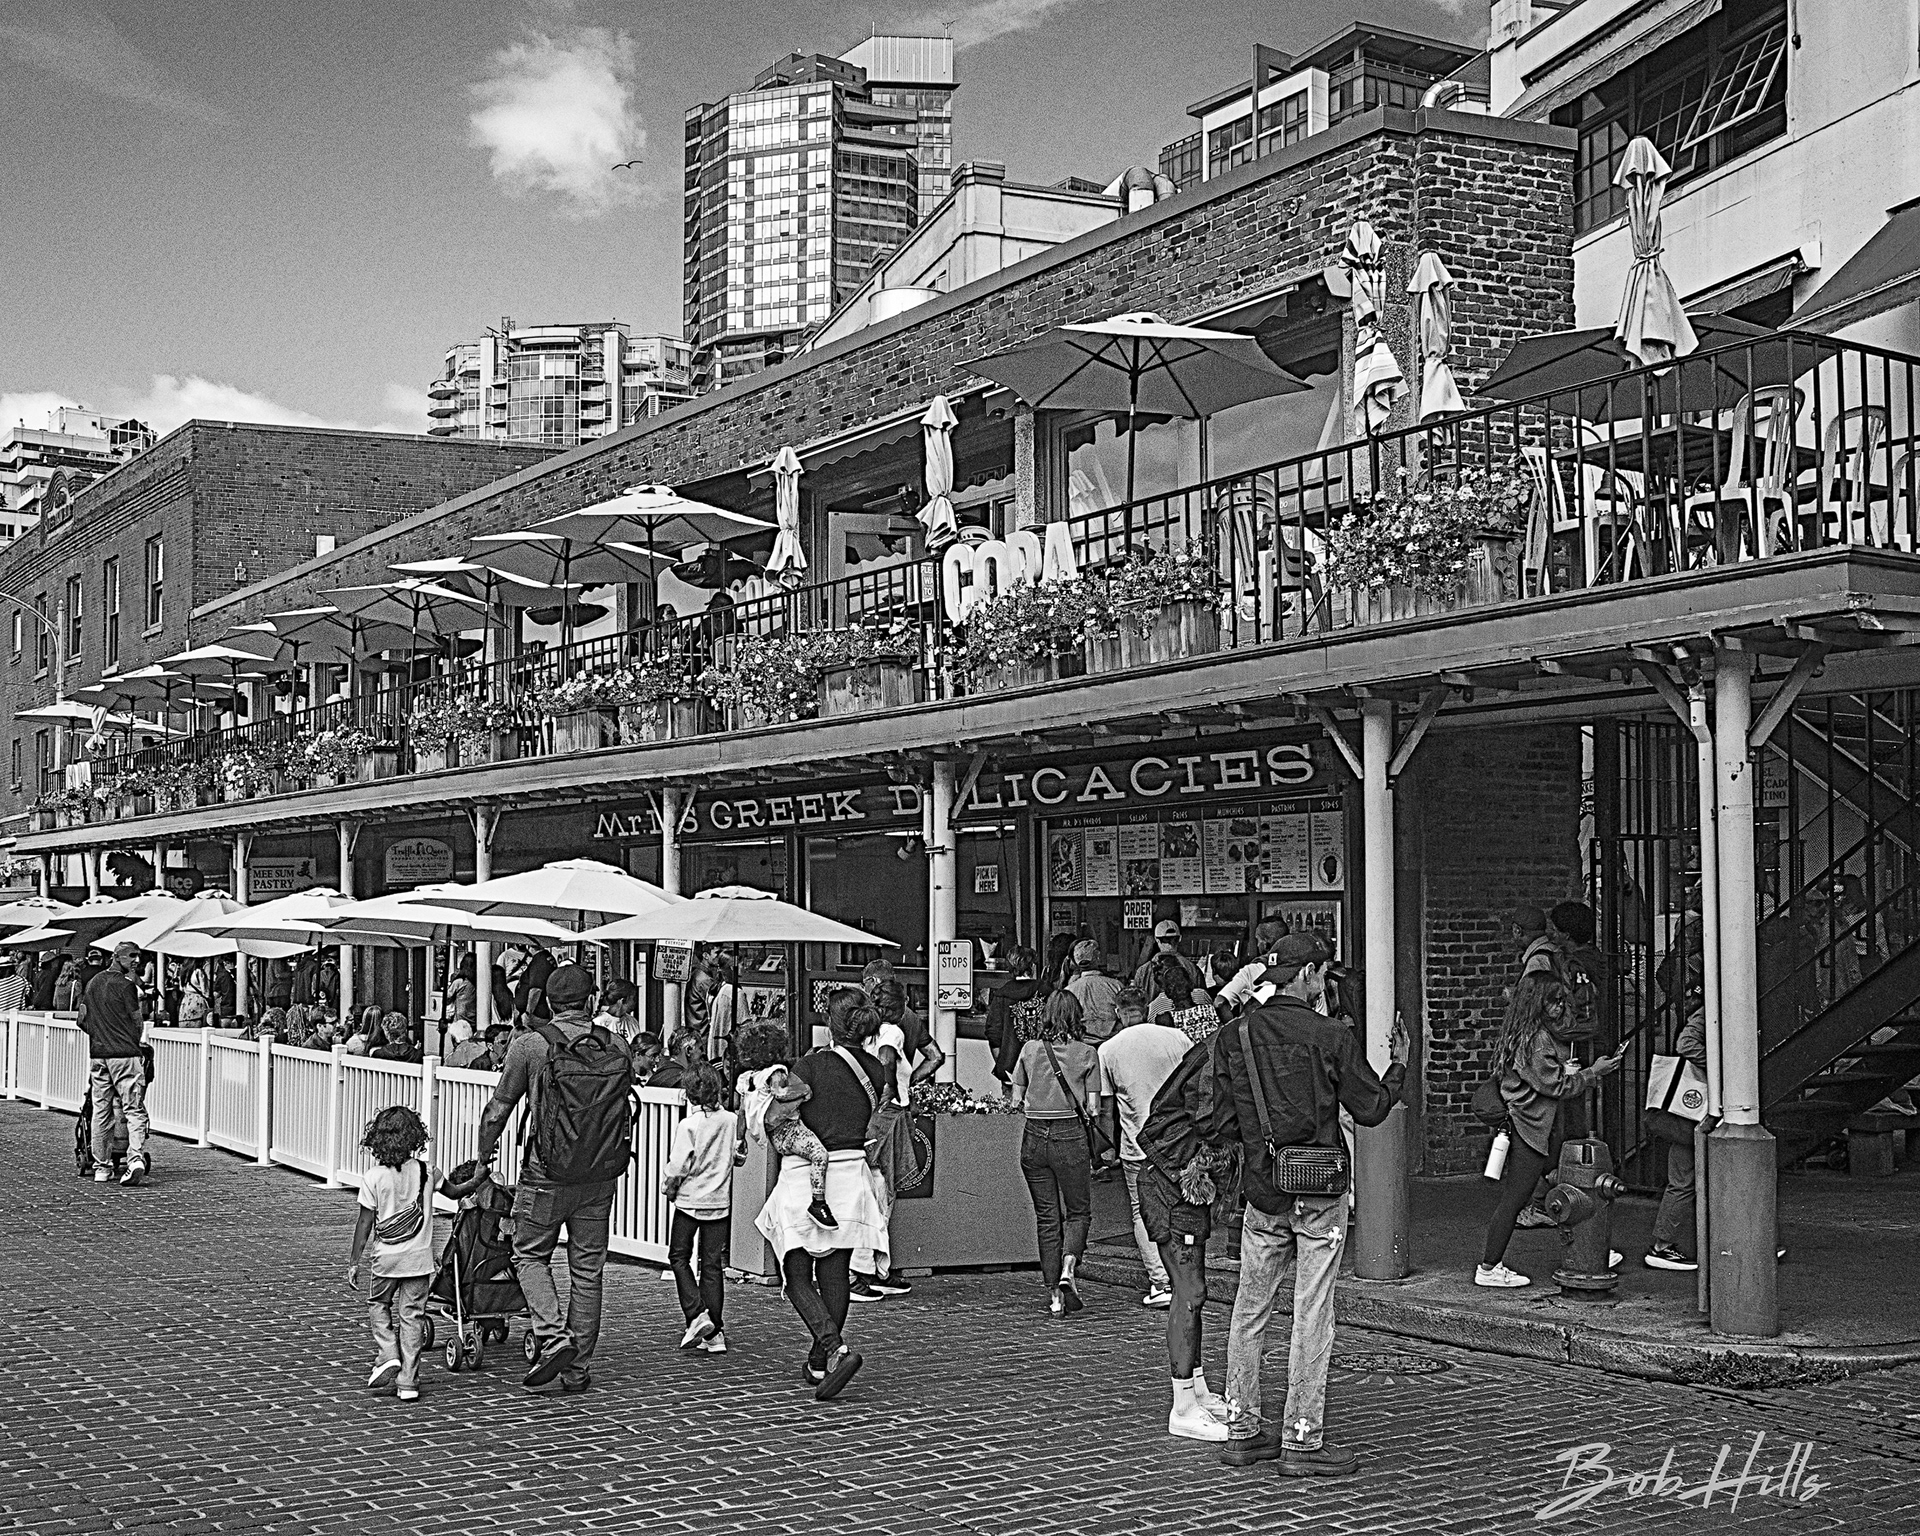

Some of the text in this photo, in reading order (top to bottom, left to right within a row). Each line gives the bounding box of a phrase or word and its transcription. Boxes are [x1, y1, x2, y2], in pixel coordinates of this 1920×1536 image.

[967, 468, 1003, 485] OPEN
[943, 521, 1077, 626] COPA
[709, 789, 866, 830] GREEK
[887, 743, 1315, 816] DLICACIES
[1271, 803, 1296, 813] PASTRIES
[1321, 800, 1339, 810] SIDES
[1172, 810, 1188, 820] FRIES
[1216, 807, 1245, 817] MUNCHIES
[1129, 813, 1148, 823] SALADS
[426, 844, 448, 857] Queen
[253, 869, 295, 878] MEE SUM
[976, 866, 998, 879] PICK UP
[253, 879, 295, 889] PASTRY
[978, 880, 996, 892] HERE
[1124, 901, 1151, 916] ORDER
[1127, 917, 1149, 928] HERE
[939, 943, 950, 953] NO
[941, 957, 968, 968] STOPS
